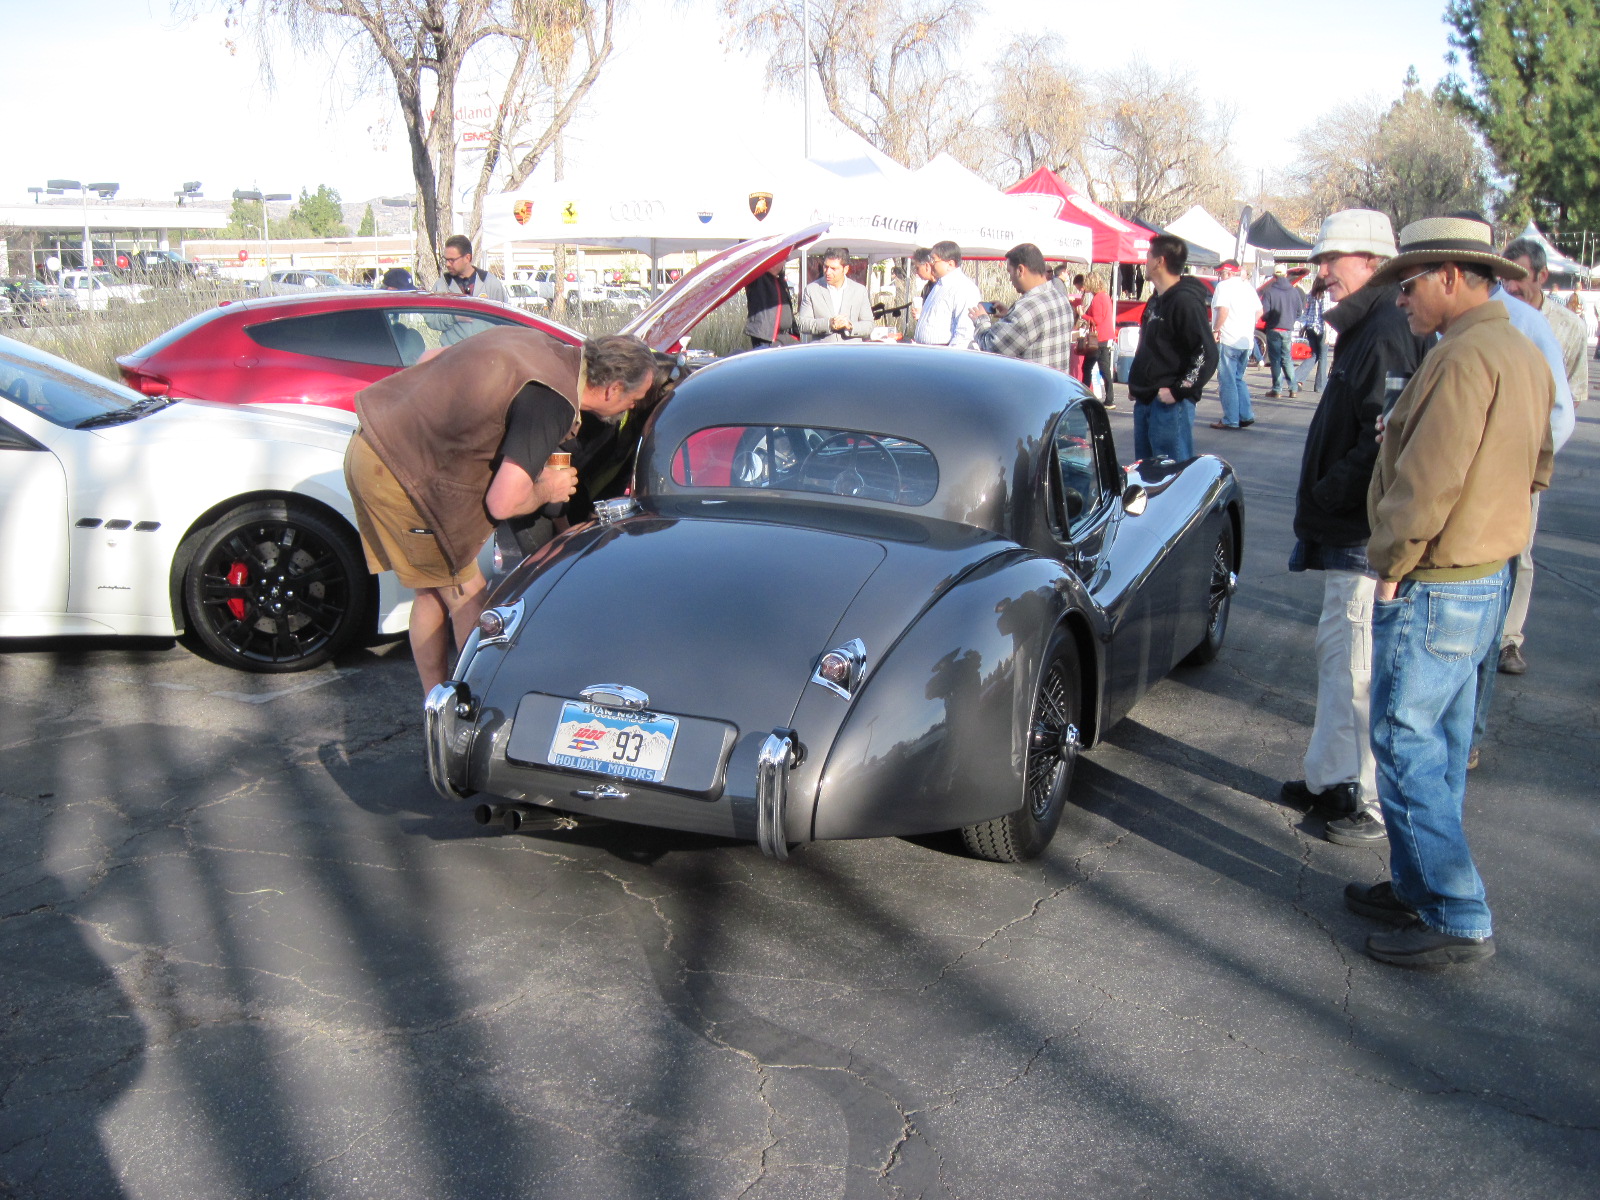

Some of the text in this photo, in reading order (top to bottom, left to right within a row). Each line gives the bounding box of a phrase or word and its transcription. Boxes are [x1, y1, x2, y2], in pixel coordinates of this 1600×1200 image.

[872, 214, 919, 235] GALLERY
[980, 227, 1014, 241] GALLERY
[591, 705, 613, 716] VAN
[613, 731, 643, 763] 93
[556, 754, 602, 771] HOLIDAY
[607, 764, 655, 781] MOTORS
